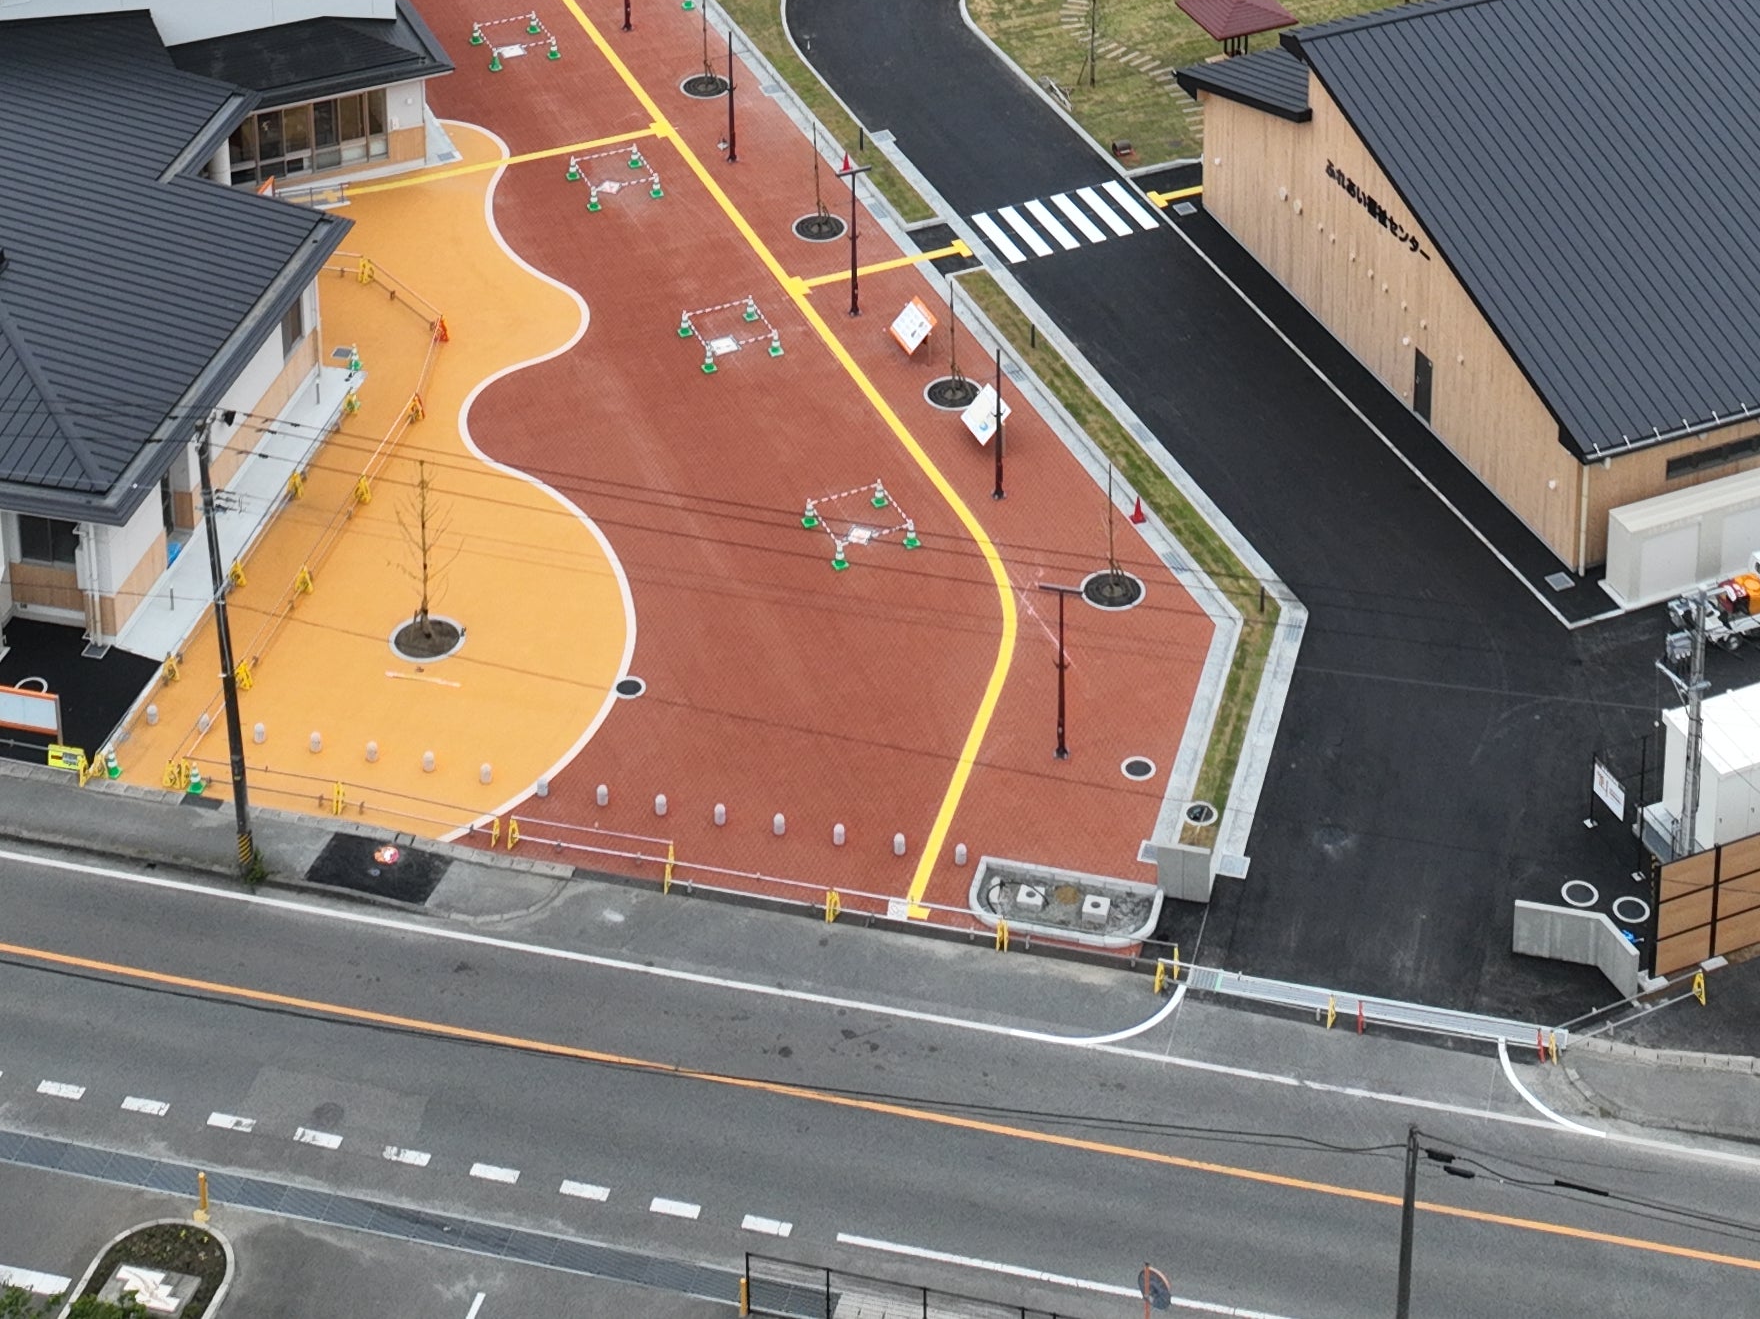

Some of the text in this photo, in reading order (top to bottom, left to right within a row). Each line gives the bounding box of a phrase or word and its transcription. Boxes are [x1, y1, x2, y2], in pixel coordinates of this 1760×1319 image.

[1325, 158, 1431, 261] ふれあい福祉センター
